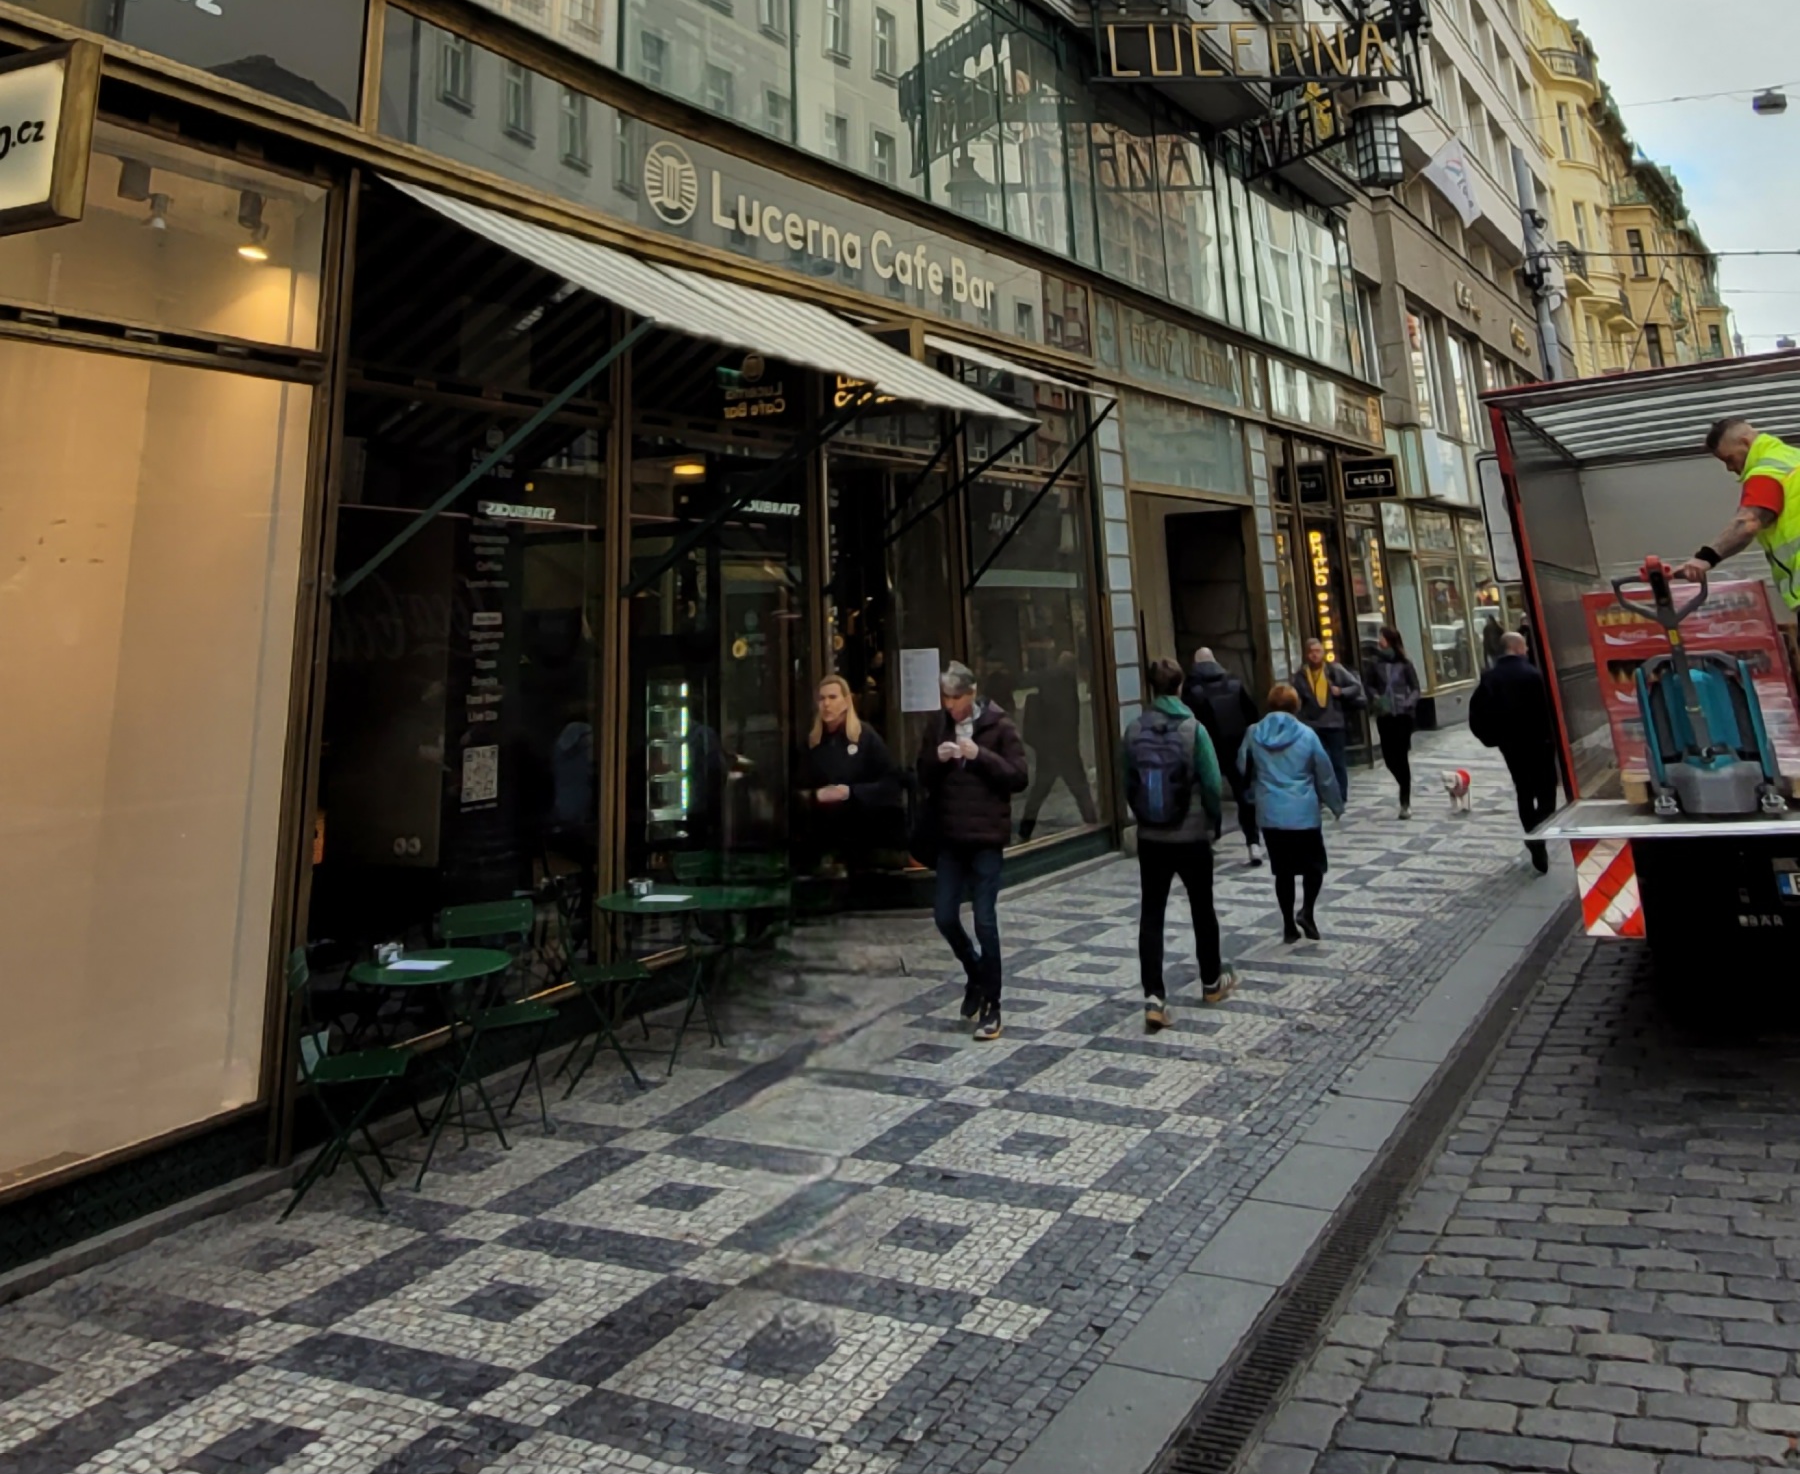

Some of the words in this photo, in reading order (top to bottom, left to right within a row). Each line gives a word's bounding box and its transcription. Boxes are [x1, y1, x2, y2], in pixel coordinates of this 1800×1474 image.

[1106, 22, 1396, 77] LUCERNA
[711, 169, 862, 271] Lucerna
[870, 230, 944, 297] Cafe
[951, 257, 996, 312] Bar
[1352, 474, 1386, 486] artio
